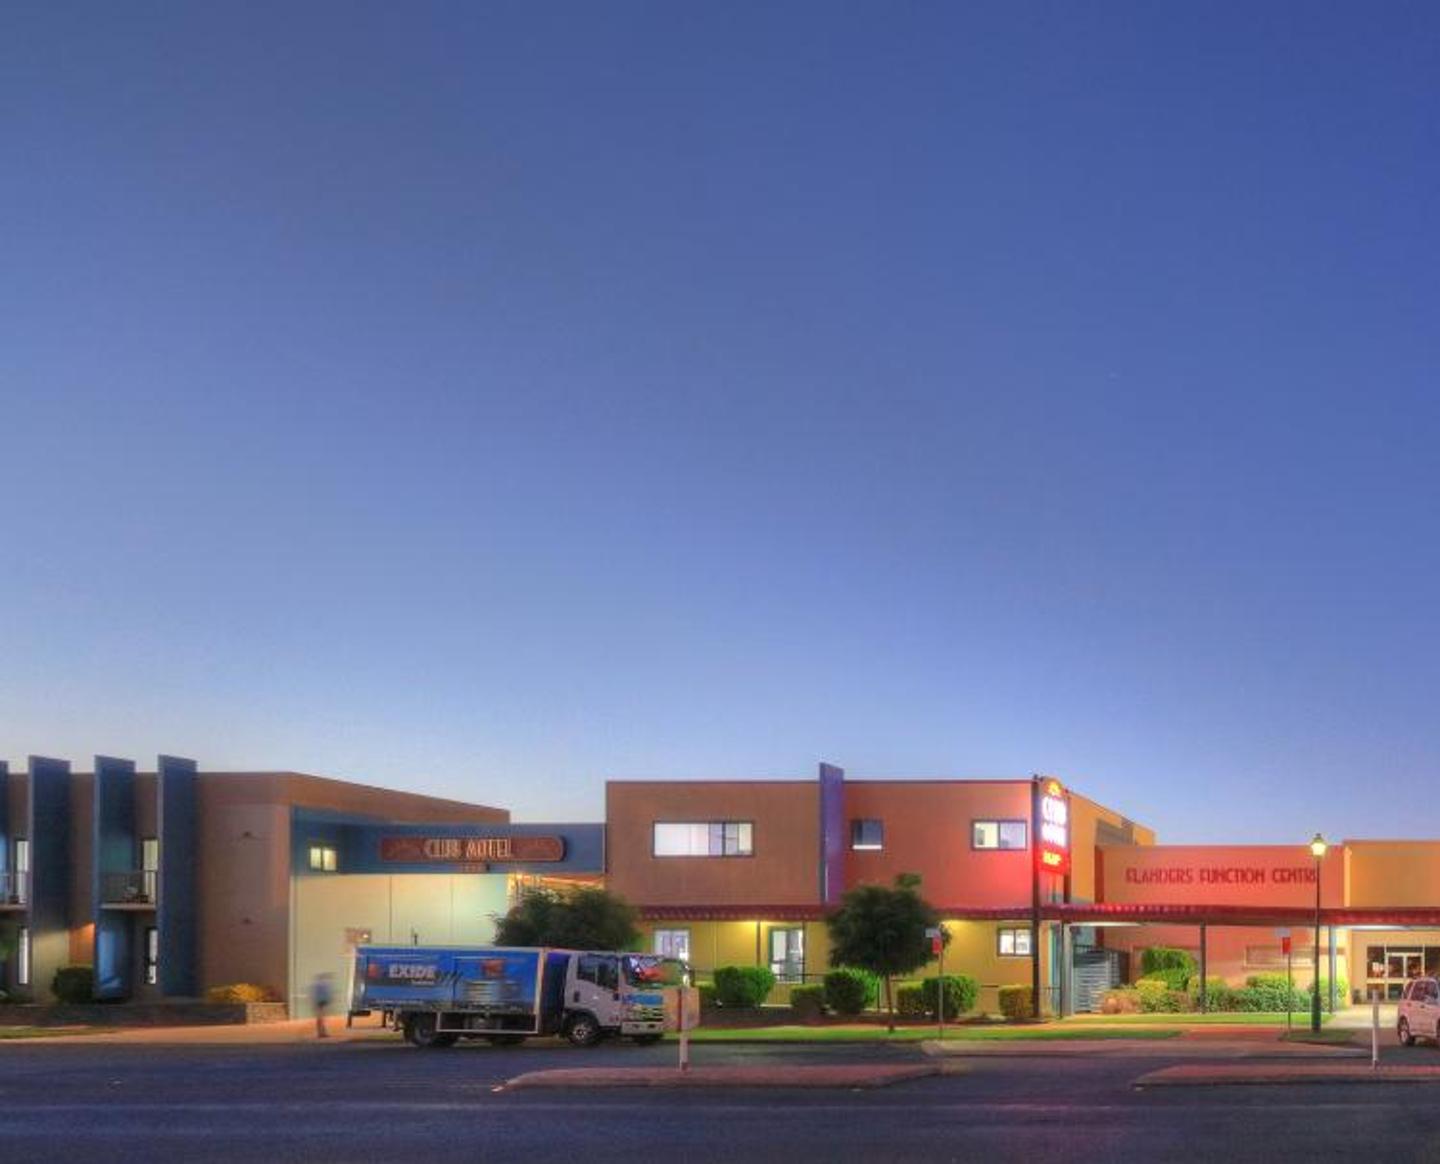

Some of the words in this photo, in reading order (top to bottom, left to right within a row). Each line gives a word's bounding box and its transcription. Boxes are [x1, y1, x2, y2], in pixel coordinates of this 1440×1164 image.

[424, 839, 462, 857] CLUB
[465, 839, 513, 857] MOTEL
[1126, 867, 1193, 884] FLANDERS
[1200, 867, 1265, 884] FUNCTION
[389, 964, 436, 979] EXIDE
